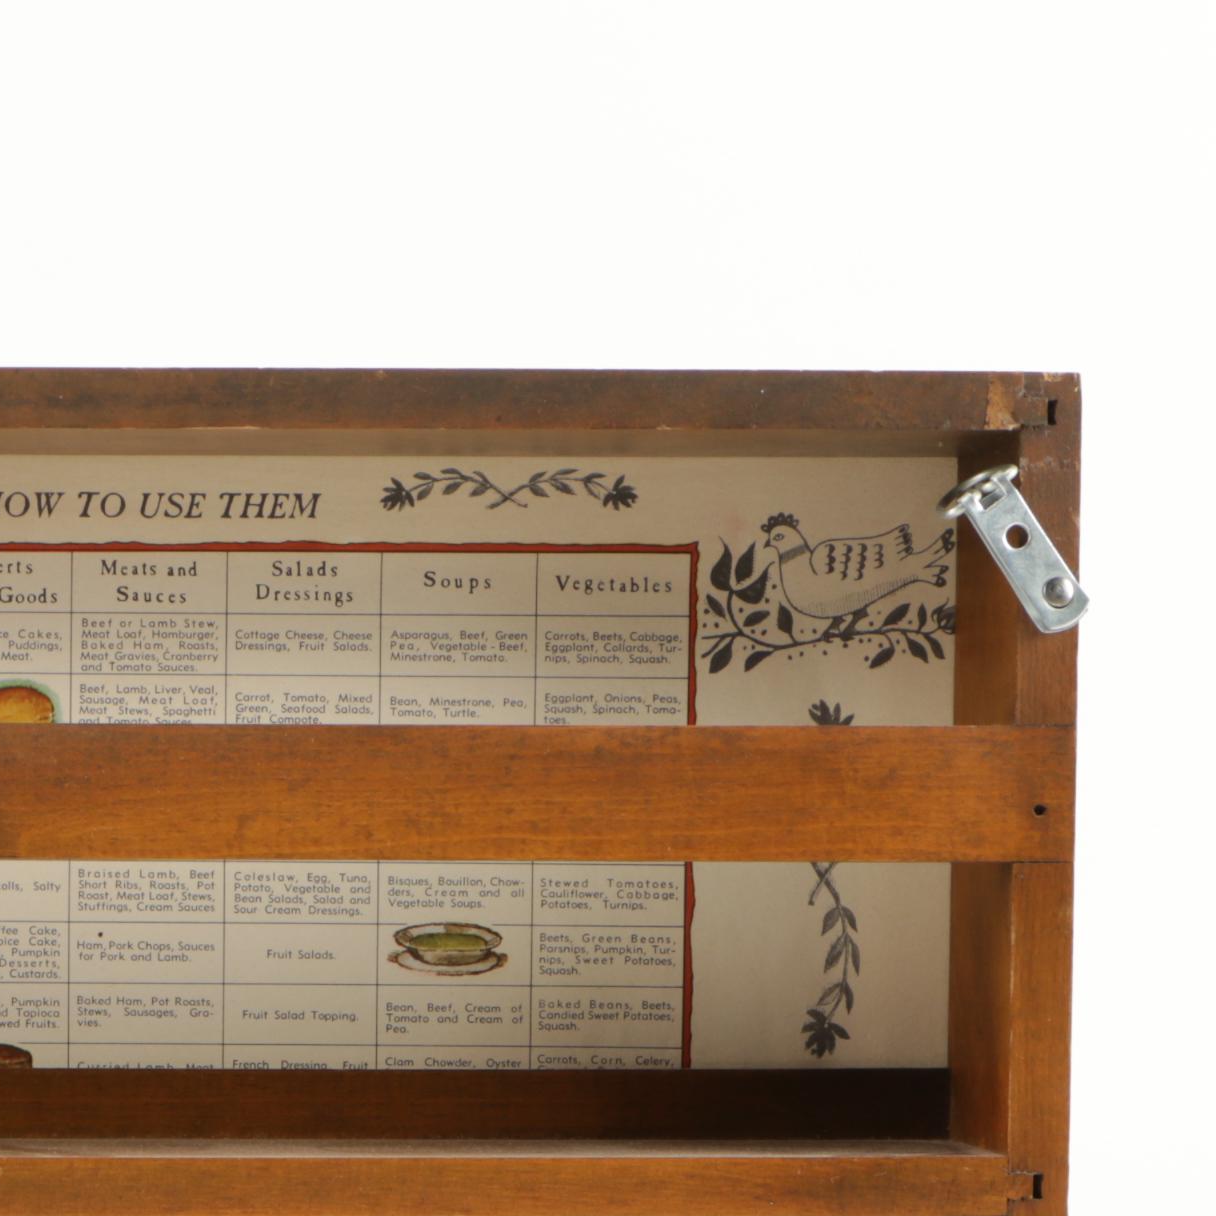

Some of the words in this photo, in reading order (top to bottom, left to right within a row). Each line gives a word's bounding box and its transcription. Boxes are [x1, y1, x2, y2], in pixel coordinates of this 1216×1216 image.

[78, 491, 126, 518] TO
[140, 492, 206, 519] USE
[219, 492, 322, 519] THEM
[101, 559, 156, 576] Meats
[167, 561, 197, 577] and
[272, 560, 338, 577] Salads
[423, 570, 491, 594] Soups
[555, 575, 672, 595] Vegetables
[116, 586, 186, 604] Sauces
[256, 584, 353, 608] Dressings
[18, 628, 59, 640] Cakes,
[234, 629, 280, 642] Cottage
[284, 630, 328, 641] Cheese,
[332, 630, 373, 641] Cheese
[8, 640, 62, 652] Puddings,
[235, 640, 290, 653] Dressings,
[298, 640, 325, 651] Fruit
[333, 641, 373, 652] Salads.
[0, 651, 33, 662] Meat.
[33, 880, 61, 893] Salty
[76, 940, 106, 952] Ham,
[108, 940, 134, 951] Pork
[136, 940, 174, 953] Chops,
[178, 940, 215, 952] Sauces
[78, 951, 94, 961] for
[100, 951, 126, 962] Pork
[130, 952, 152, 962] and
[157, 952, 192, 962] Lamb.
[266, 948, 292, 959] Fruit
[298, 949, 337, 960] Salads.
[538, 999, 581, 1009] Baked
[589, 999, 633, 1011] Beans,
[641, 1000, 675, 1010] Beets,
[242, 1009, 268, 1020] Fruit
[274, 1010, 305, 1020] Salad
[311, 1010, 360, 1023] Topping.
[538, 1009, 585, 1020] Candied
[588, 1010, 620, 1020] Sweet
[623, 1010, 674, 1022] Potatoes,
[538, 1020, 581, 1032] Squash.
